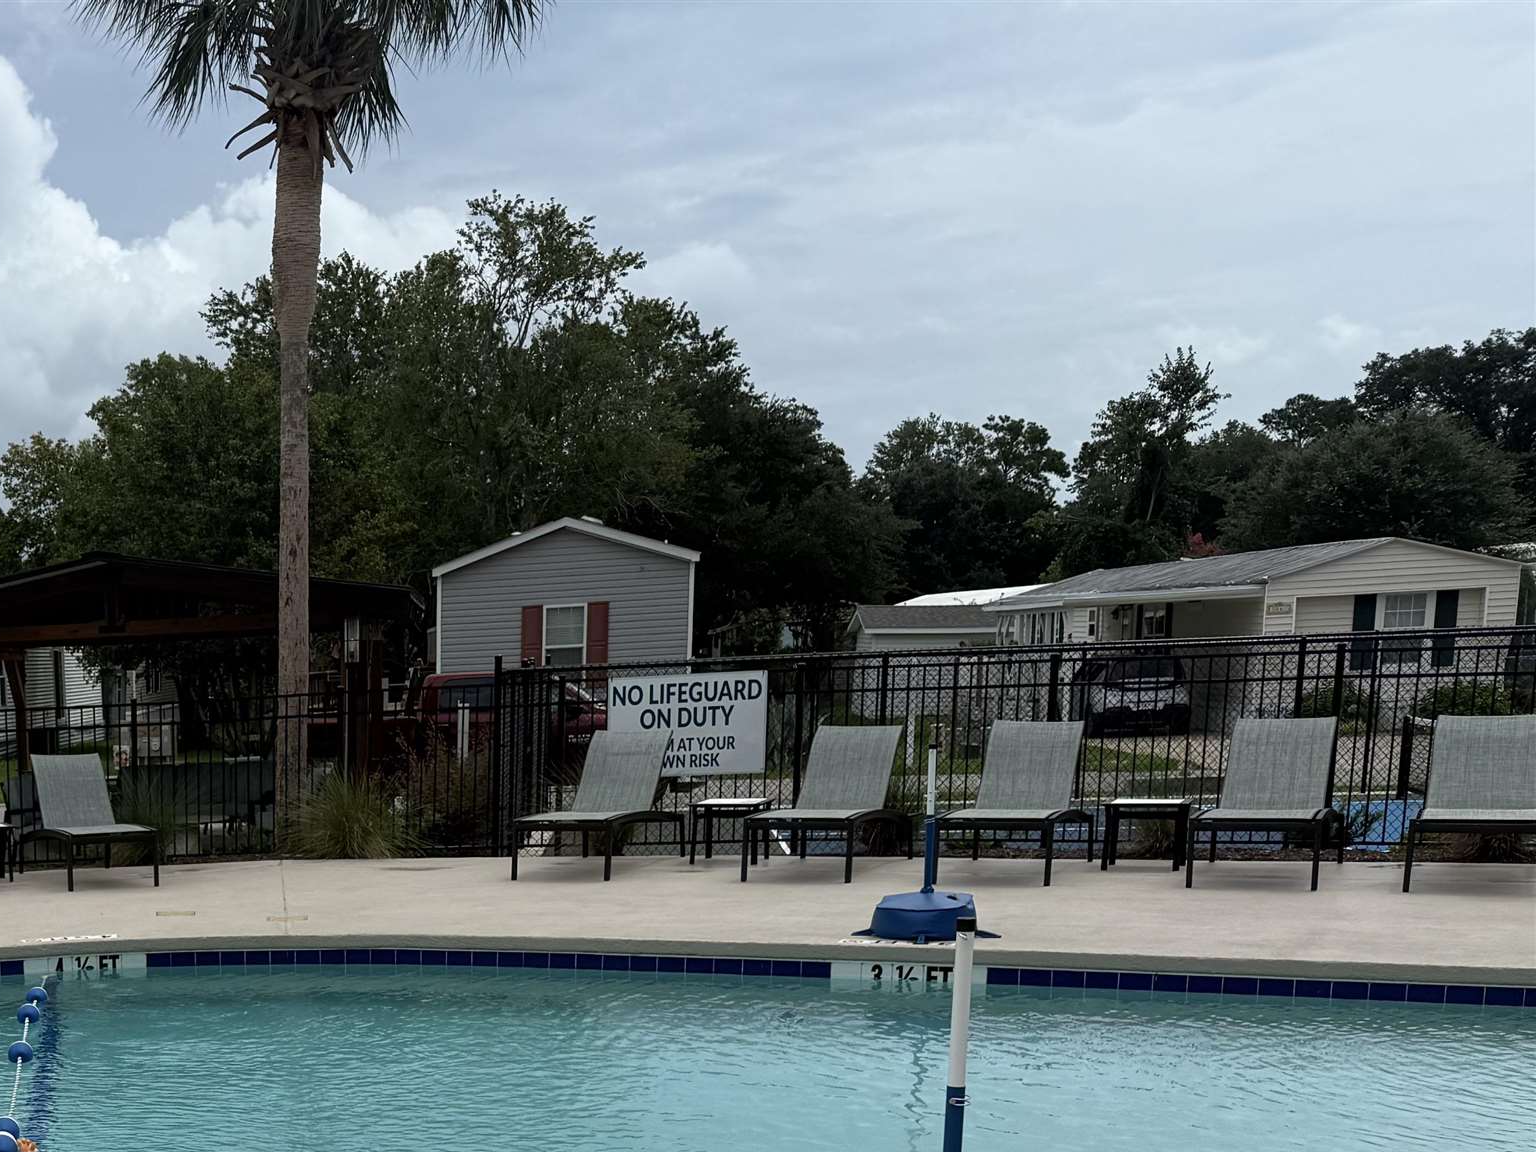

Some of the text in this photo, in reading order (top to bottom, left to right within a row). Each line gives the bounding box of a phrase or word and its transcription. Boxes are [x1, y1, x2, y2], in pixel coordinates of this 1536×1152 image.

[612, 679, 763, 707] NO LIFEGUARD
[640, 705, 735, 729] ON DUTY
[676, 737, 695, 752] AT
[696, 736, 736, 751] YOUR
[663, 753, 720, 769] WN RISK
[99, 954, 120, 970] FT
[926, 966, 954, 982] FT
